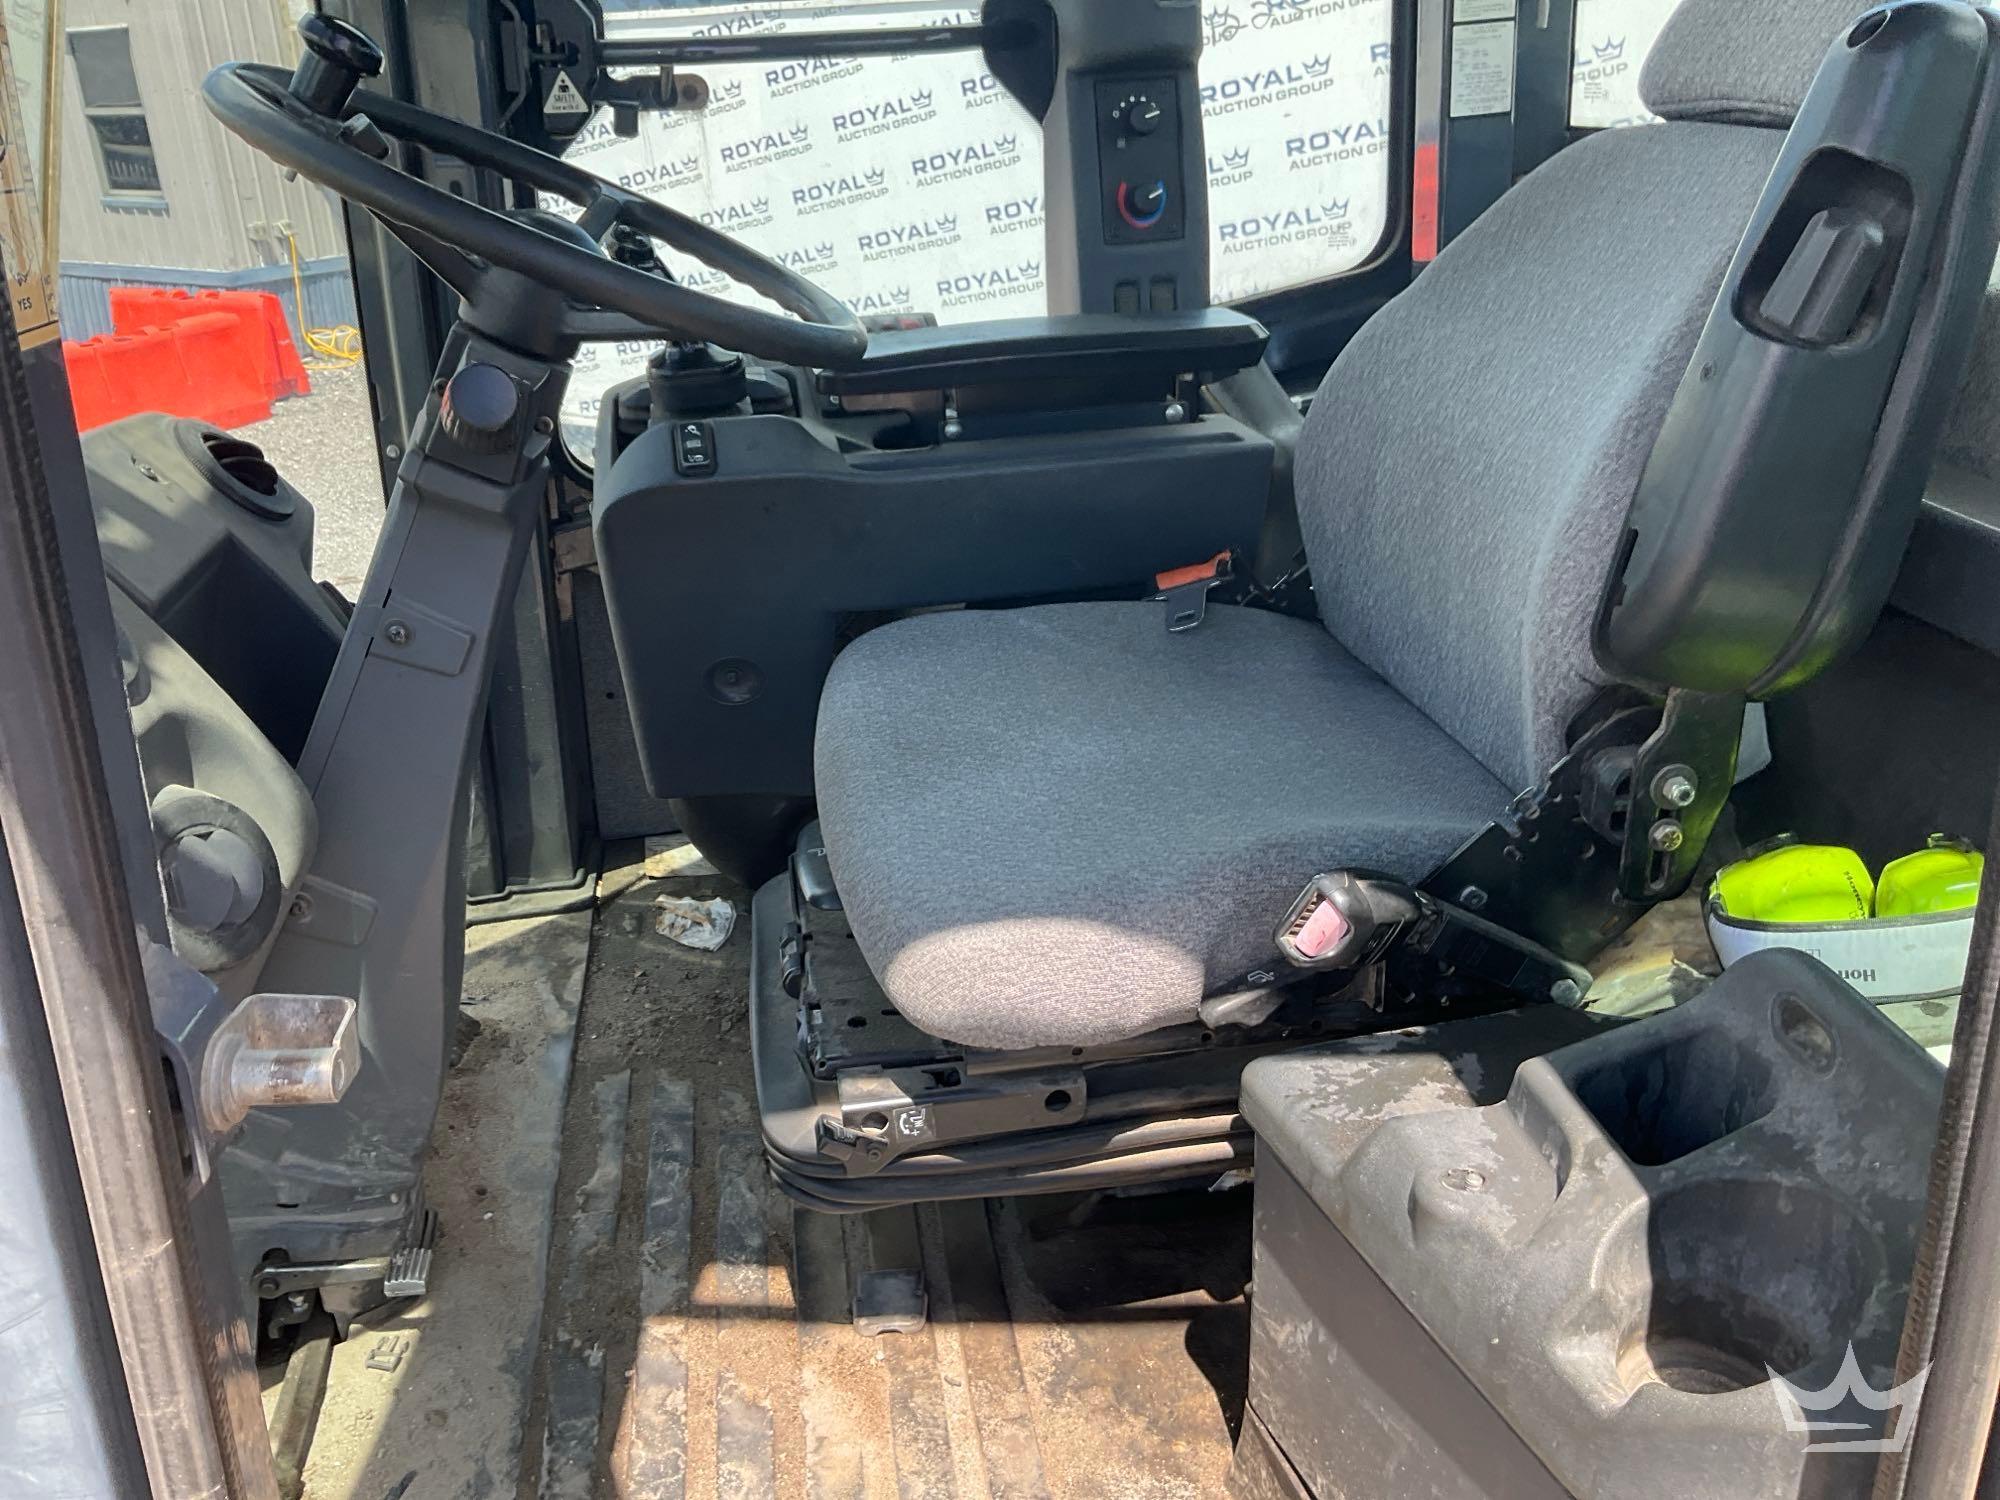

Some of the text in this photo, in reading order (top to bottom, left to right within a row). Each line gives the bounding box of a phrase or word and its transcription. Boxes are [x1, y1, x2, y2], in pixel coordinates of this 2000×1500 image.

[770, 64, 864, 98] AUCTION GROUP
[1200, 65, 1303, 104] ROYAL
[709, 100, 746, 117] GROUP
[1203, 79, 1334, 118] AUCTION GROUP
[832, 98, 913, 132] ROYAL
[837, 110, 937, 144] AUCTION GROUP
[720, 132, 790, 162] ROYAL
[725, 143, 813, 174] AUCTION GROUP
[911, 143, 996, 176] ROYAL
[1289, 144, 1363, 172] AUCTION
[619, 161, 683, 188] ROYAL
[916, 155, 1022, 188] AUCTION GROUP
[1210, 171, 1253, 189] ROUP
[792, 175, 865, 205] ROYAL
[797, 187, 889, 217] AUCTION GROUP
[697, 203, 753, 227] OYAL
[986, 197, 1045, 223] ROY
[1219, 208, 1321, 242] ROYAL
[858, 222, 937, 251] ROYAL
[863, 234, 961, 263] AUCTION GROUP
[1222, 221, 1352, 255] AUCTION GROUP
[775, 248, 818, 267] YAL
[937, 267, 1019, 297] ROYAL
[941, 281, 1044, 308] AUCTION GROUP
[17, 297, 33, 311] YES
[846, 292, 890, 312] YAL
